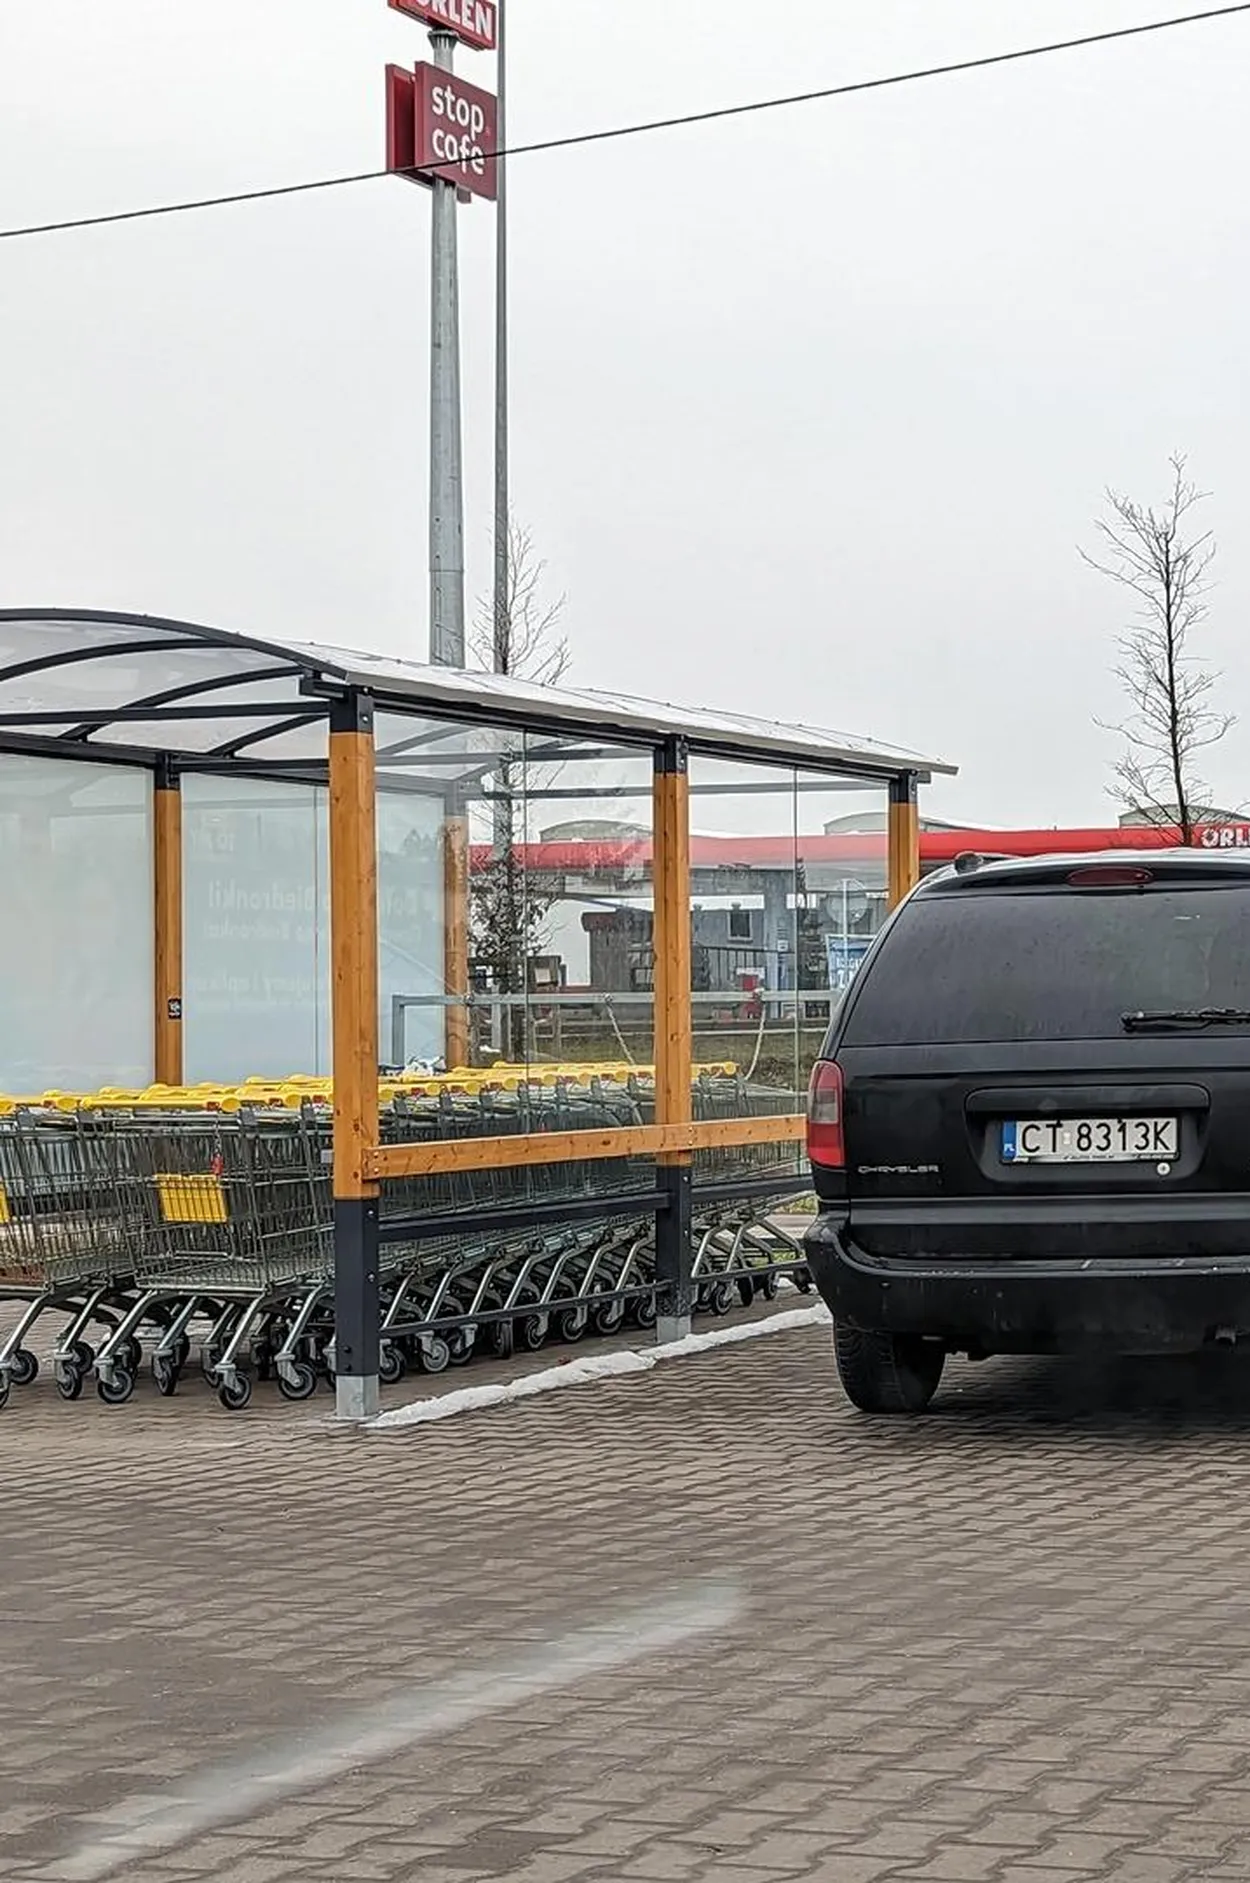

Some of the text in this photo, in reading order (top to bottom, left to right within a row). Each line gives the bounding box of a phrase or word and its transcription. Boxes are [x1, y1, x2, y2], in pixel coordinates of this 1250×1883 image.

[417, 0, 493, 41] RLEN
[431, 84, 484, 141] stop
[1021, 1121, 1171, 1153] CT 8313K
[857, 1164, 940, 1174] CHRYSLER
